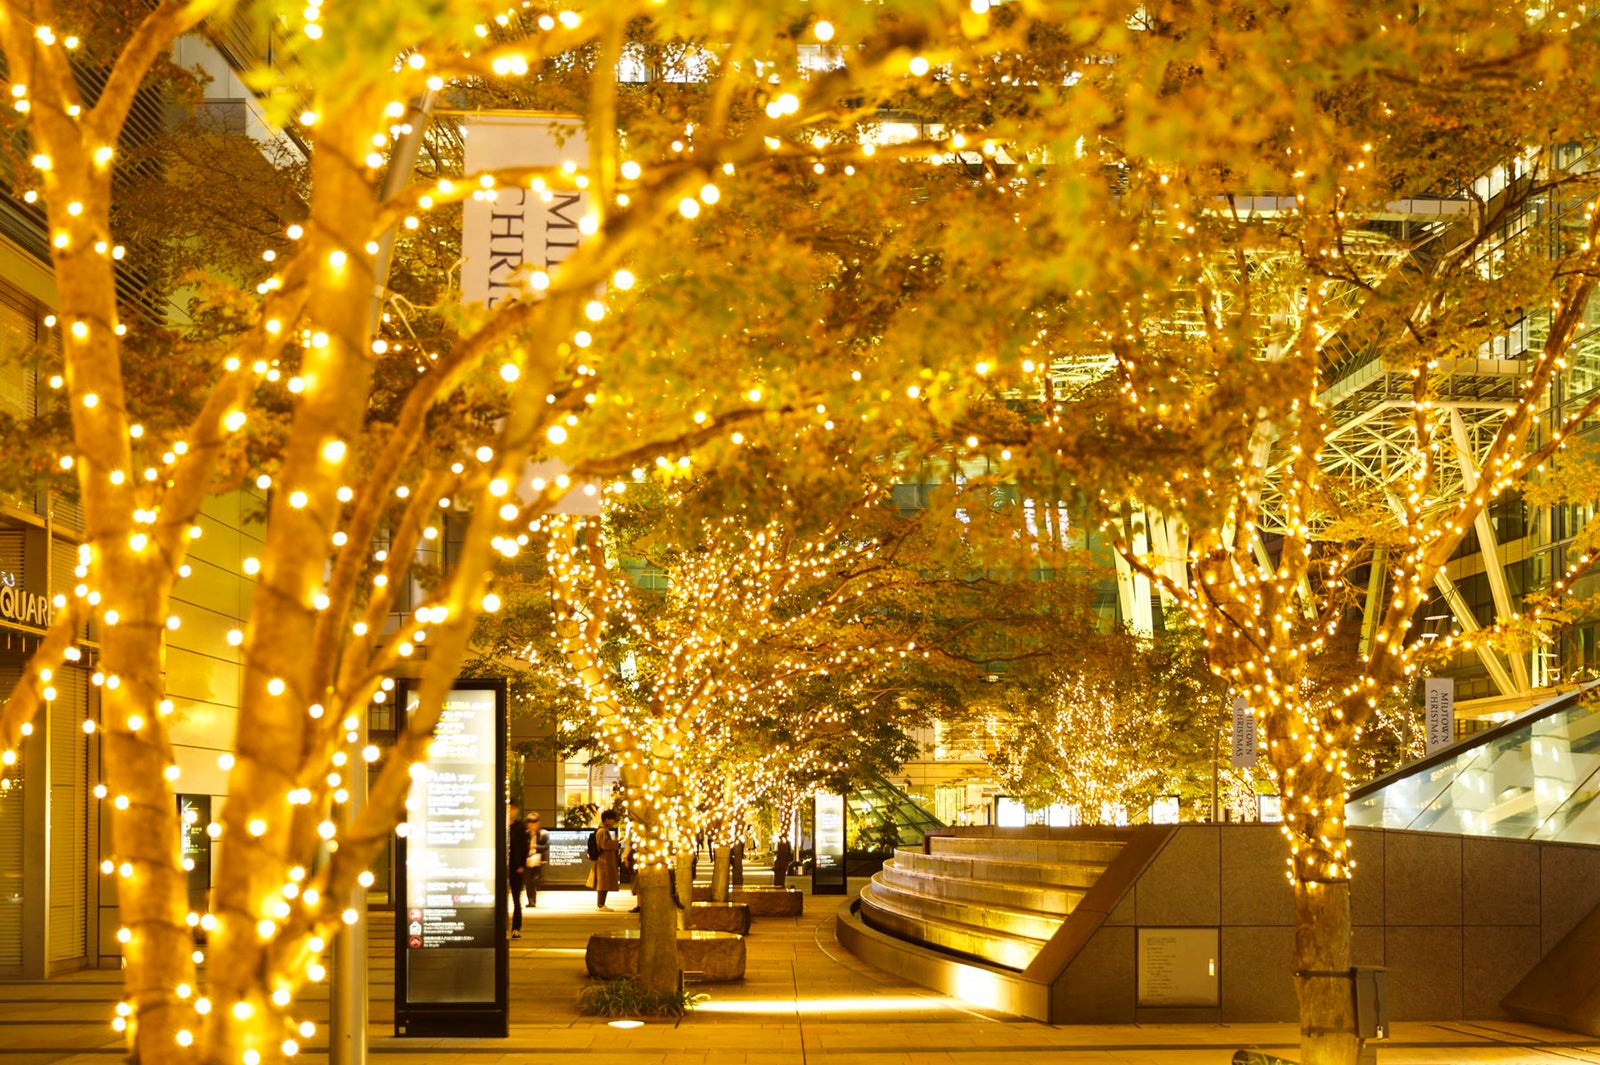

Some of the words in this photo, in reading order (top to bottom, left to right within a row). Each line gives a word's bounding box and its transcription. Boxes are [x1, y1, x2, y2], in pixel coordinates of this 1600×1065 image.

[1235, 708, 1244, 757] CHRISTMAS
[1245, 715, 1254, 756] IDTOWN
[1430, 689, 1440, 745] CHRISTMAS
[1440, 692, 1449, 743] MIDTOWN
